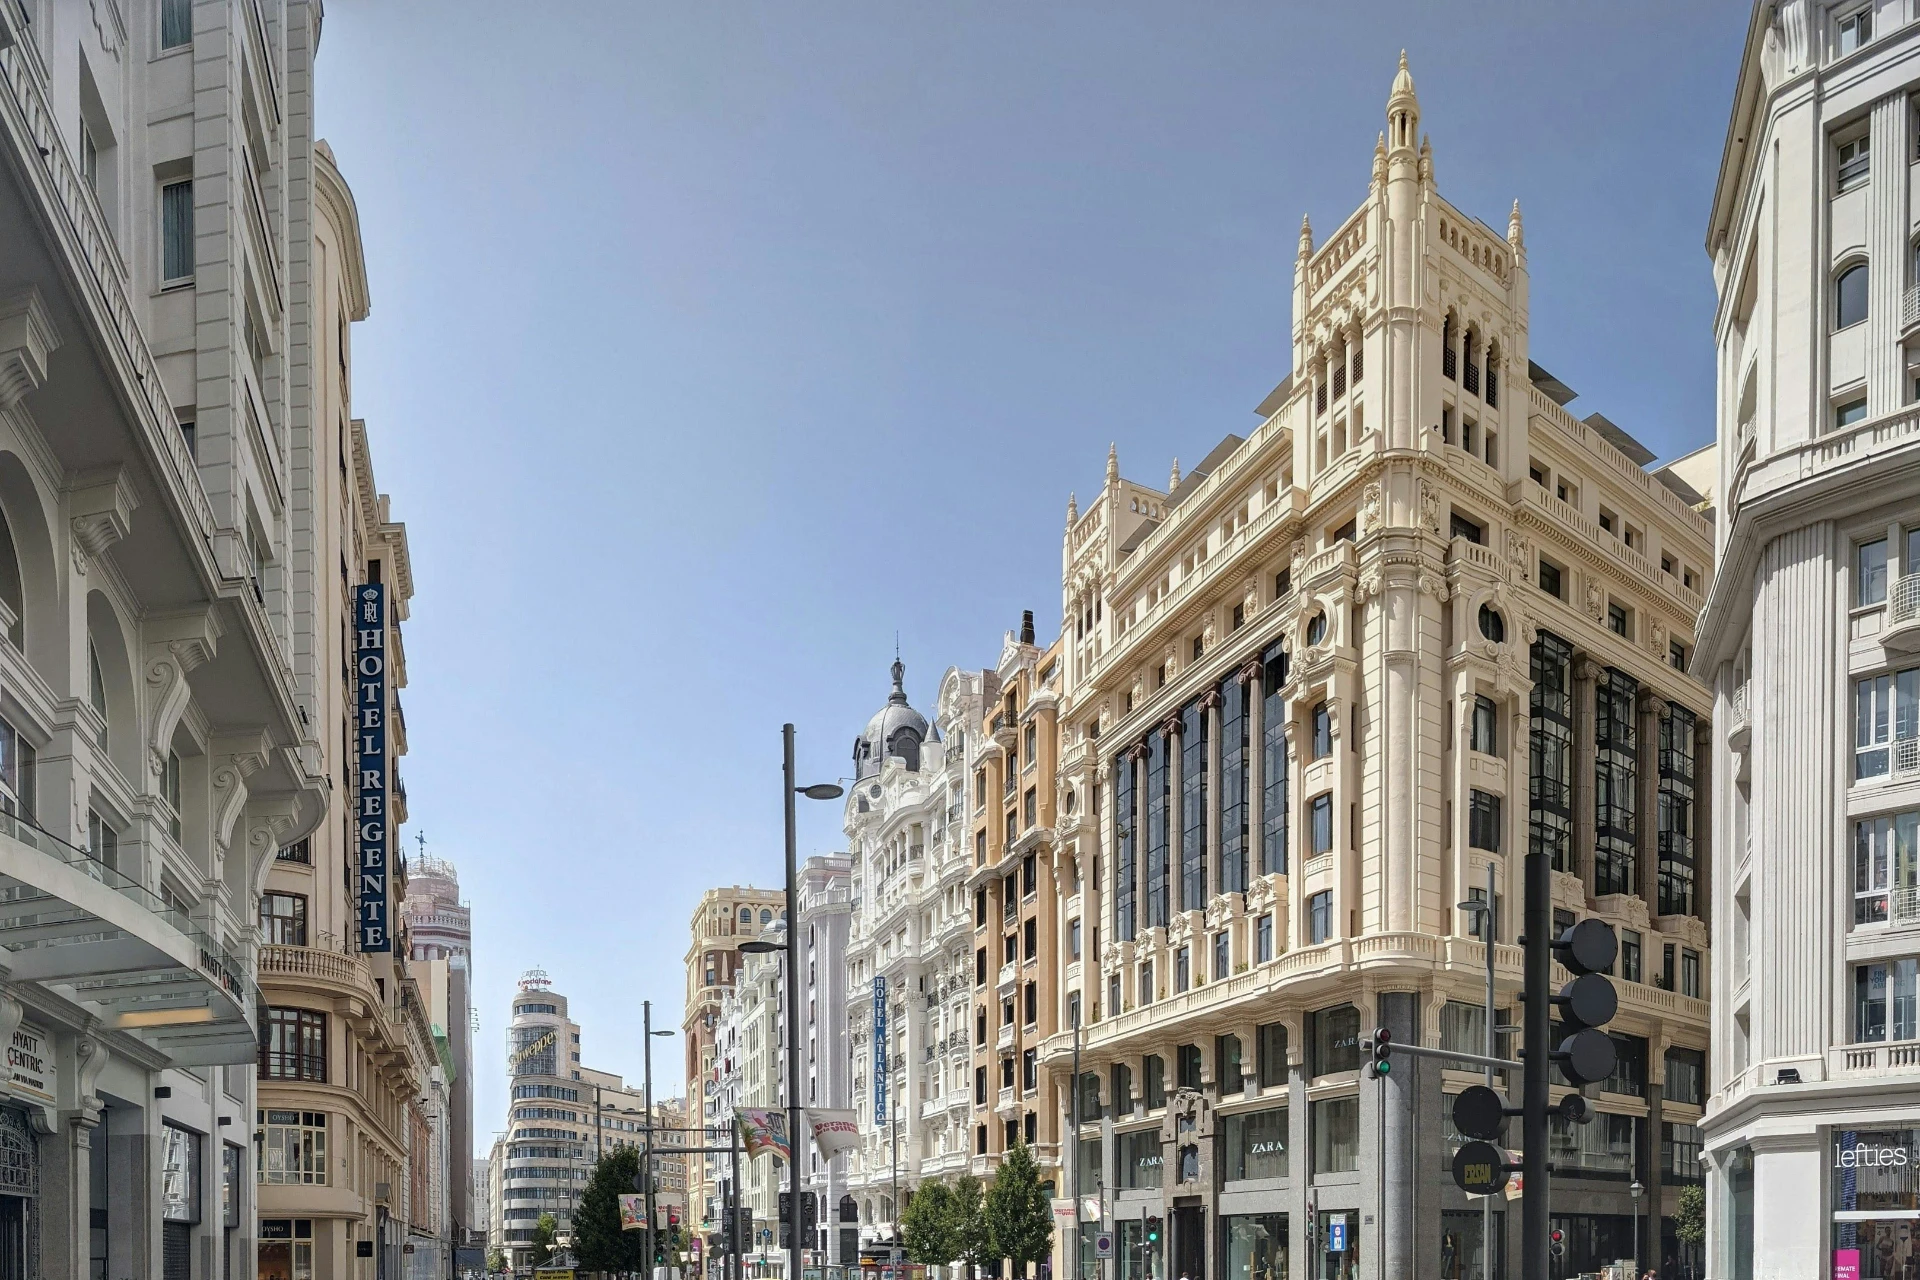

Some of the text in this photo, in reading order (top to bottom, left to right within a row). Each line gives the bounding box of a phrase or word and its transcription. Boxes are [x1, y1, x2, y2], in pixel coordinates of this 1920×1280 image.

[358, 629, 385, 947] HOTEL REGENTE
[200, 948, 222, 981] HYATT
[12, 1030, 39, 1054] HYATT
[875, 978, 885, 1121] HOTEL ATLANTICO
[7, 1046, 44, 1075] CENTRIC
[1139, 1155, 1164, 1167] ZARA
[1251, 1140, 1284, 1154] ZARA
[1834, 1142, 1907, 1169] lefties
